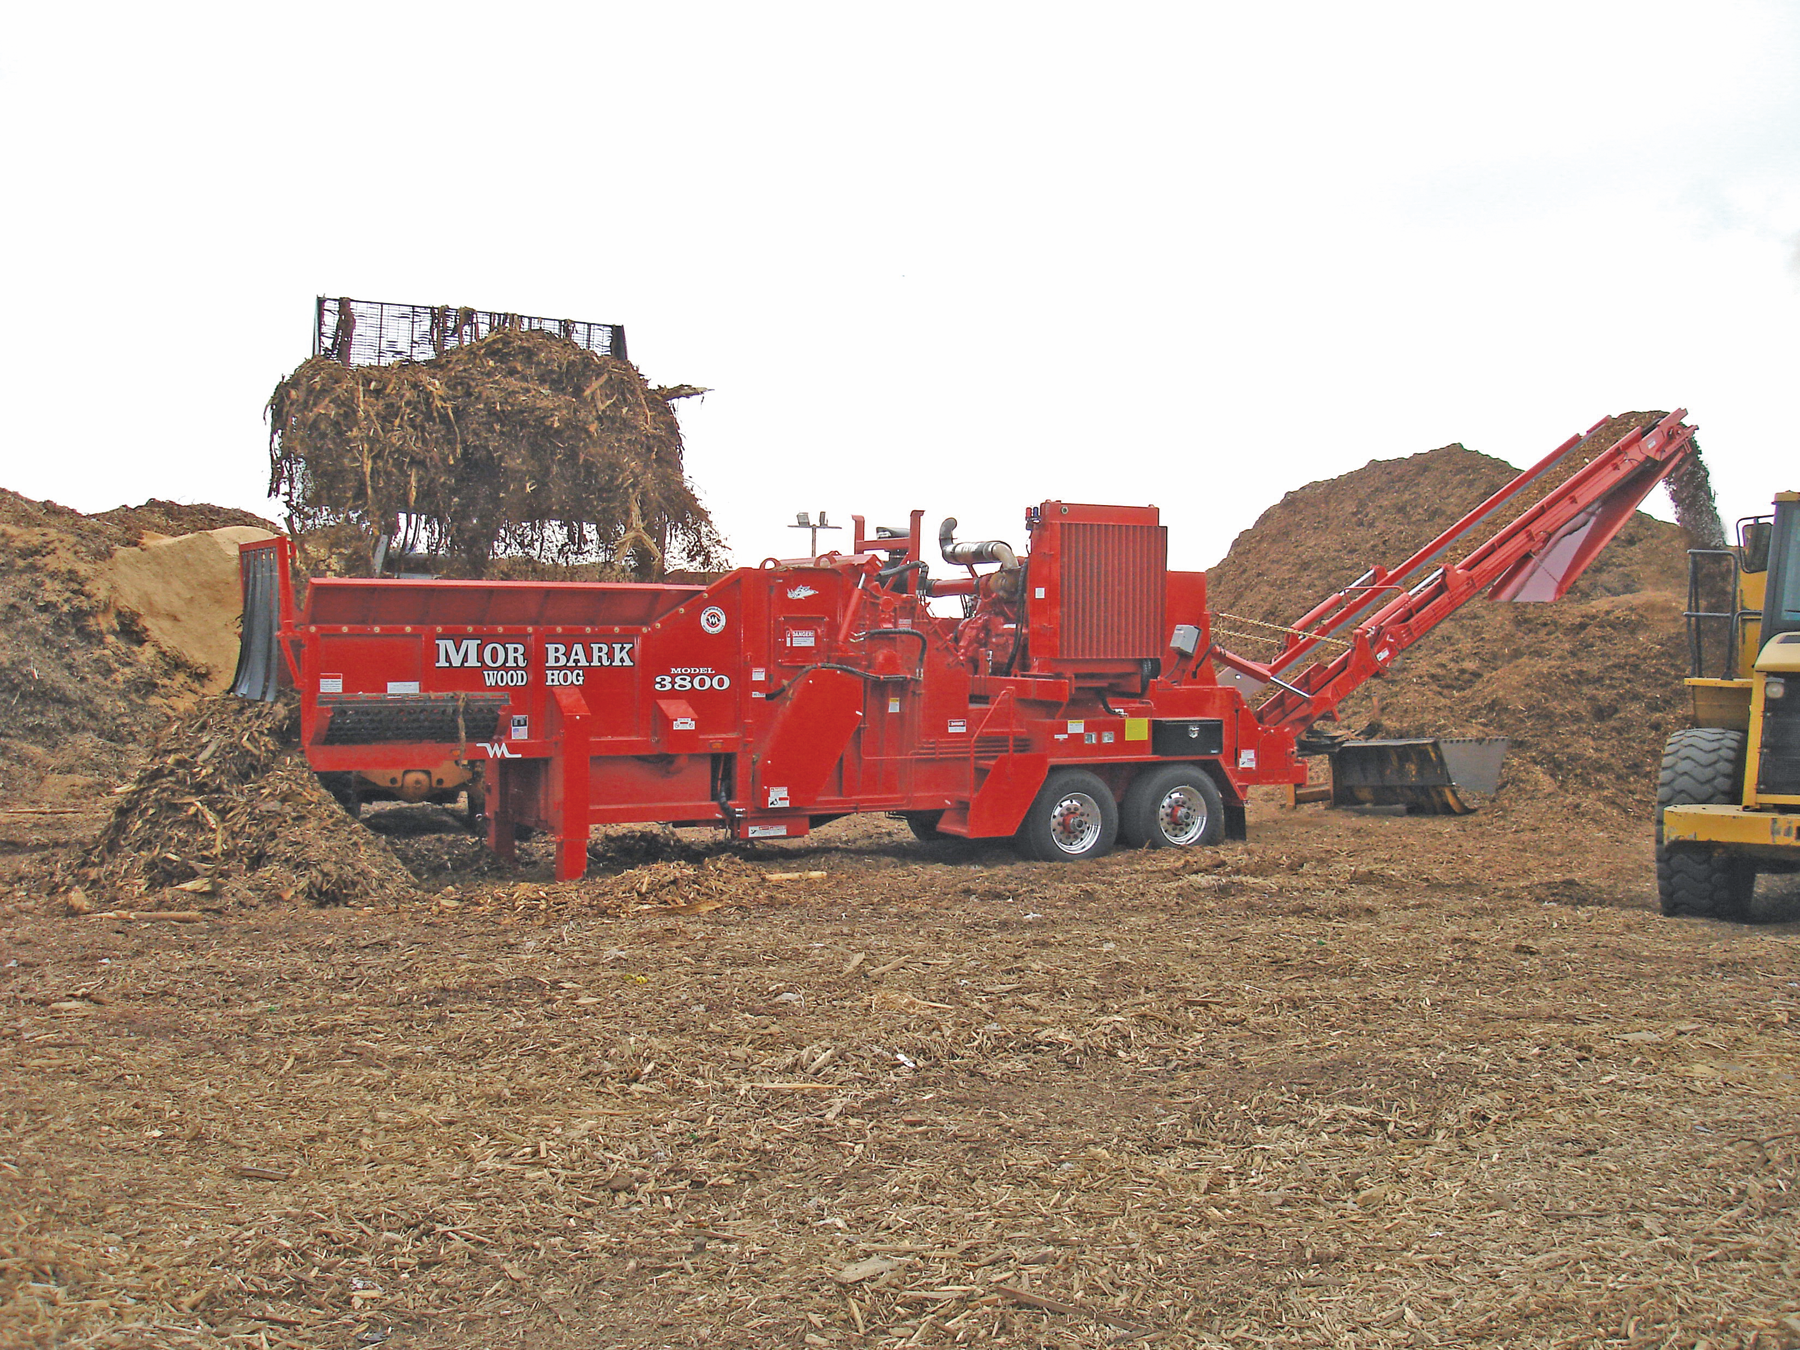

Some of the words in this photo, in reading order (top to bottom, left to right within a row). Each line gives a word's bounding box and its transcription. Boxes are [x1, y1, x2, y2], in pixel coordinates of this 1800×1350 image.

[435, 639, 528, 667] MOR
[545, 643, 634, 667] BARK
[482, 670, 528, 686] WOOD
[545, 670, 585, 686] HOG
[654, 674, 731, 691] 3800
